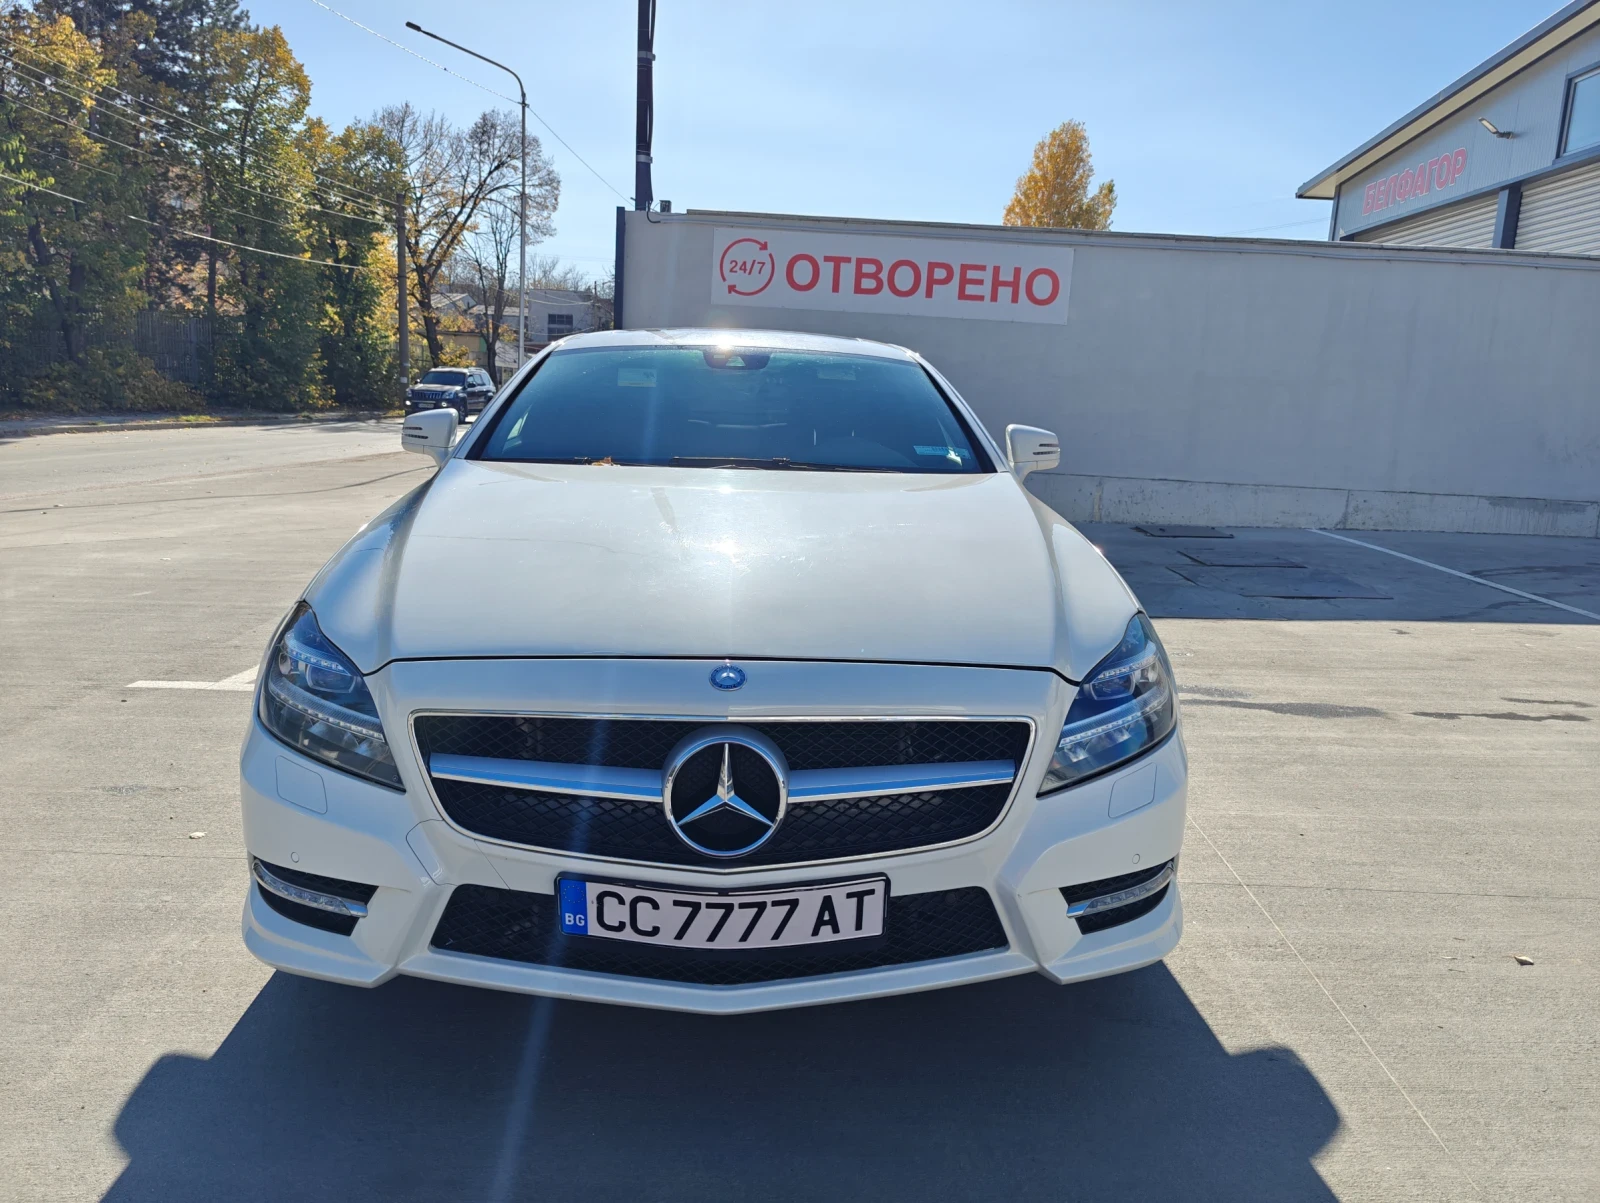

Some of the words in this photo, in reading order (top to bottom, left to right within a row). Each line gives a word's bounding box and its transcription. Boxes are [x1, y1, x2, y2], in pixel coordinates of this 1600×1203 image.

[1362, 147, 1467, 216] БЕЛФАГОР
[729, 259, 766, 275] 24/7
[785, 253, 1060, 306] ОТВОРЕНО
[565, 912, 585, 926] BG
[596, 890, 660, 937] CC
[673, 898, 799, 943] 7777
[811, 889, 876, 937] AT
